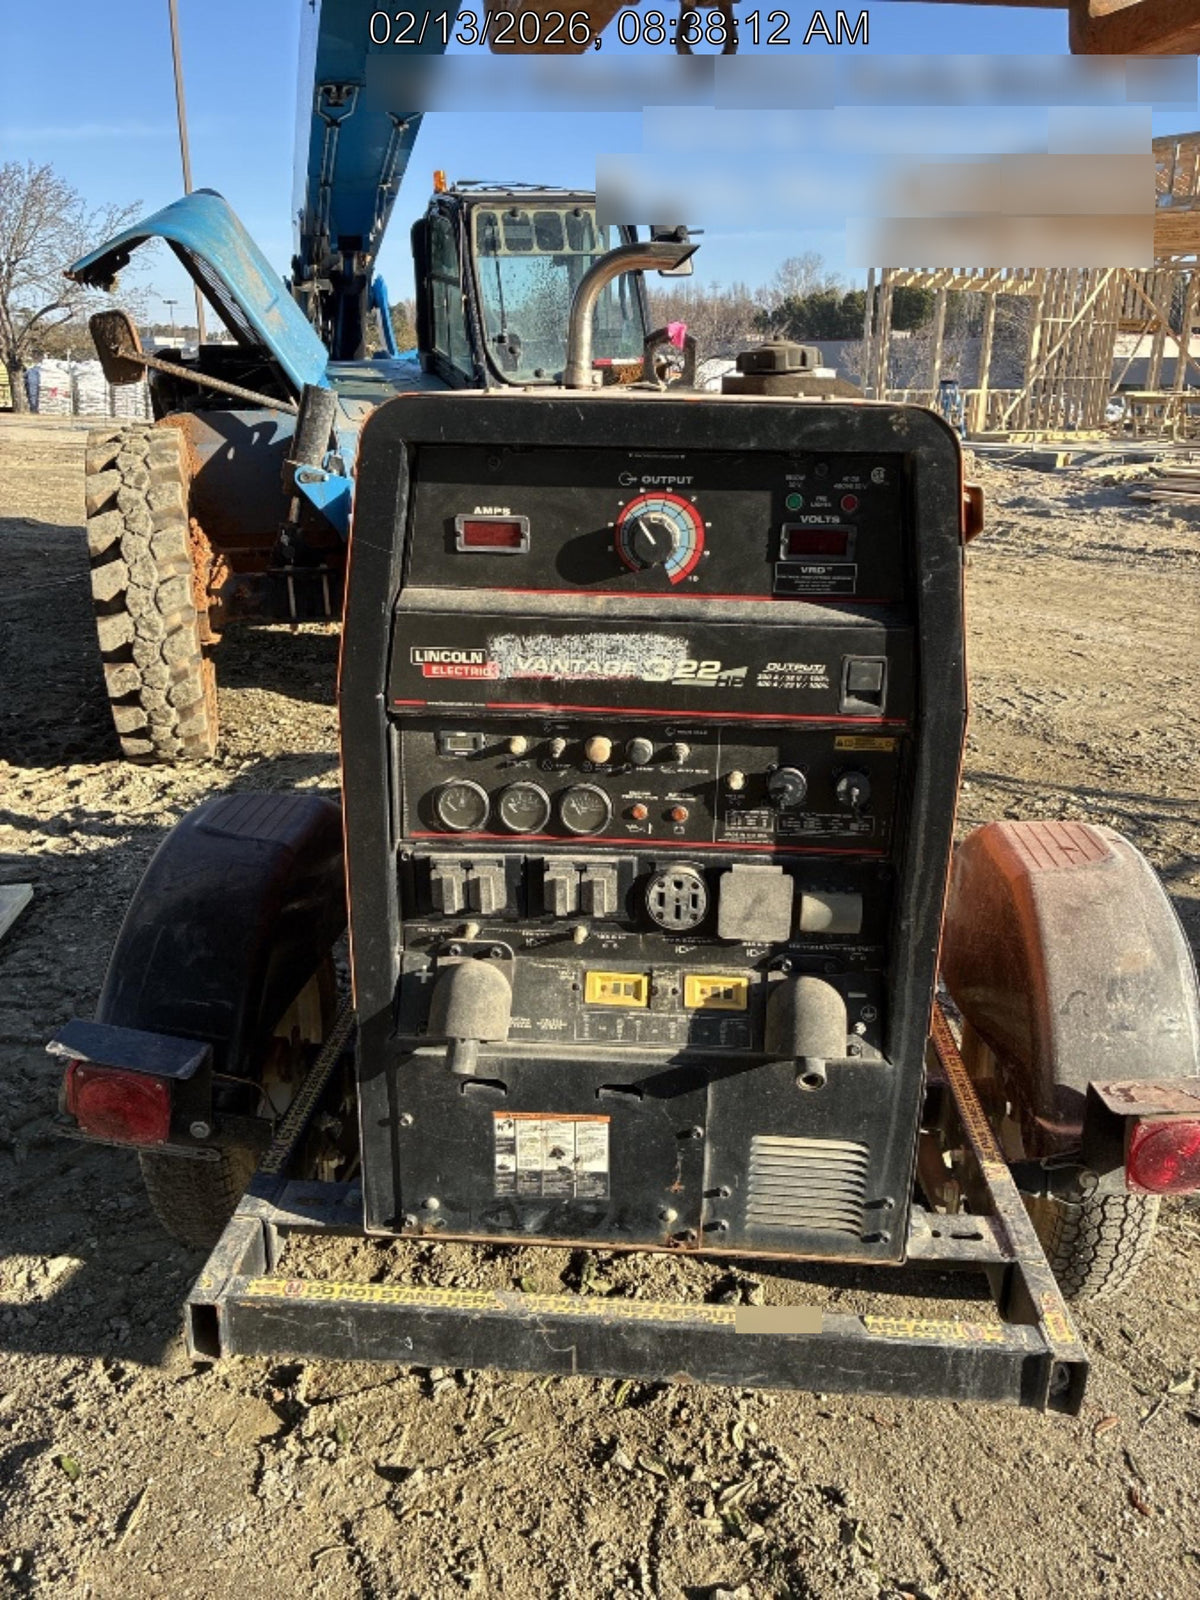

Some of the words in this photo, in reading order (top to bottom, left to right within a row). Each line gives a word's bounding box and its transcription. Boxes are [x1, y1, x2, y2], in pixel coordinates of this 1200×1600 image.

[641, 475, 694, 485] OUTPUT
[473, 506, 511, 515] AMPS
[800, 515, 840, 524] VOLTS
[415, 650, 483, 664] LINCOLN
[307, 1284, 335, 1296] DO
[338, 1286, 378, 1299] NOT
[381, 1289, 443, 1303] STAND
[449, 1294, 498, 1305] HERE
